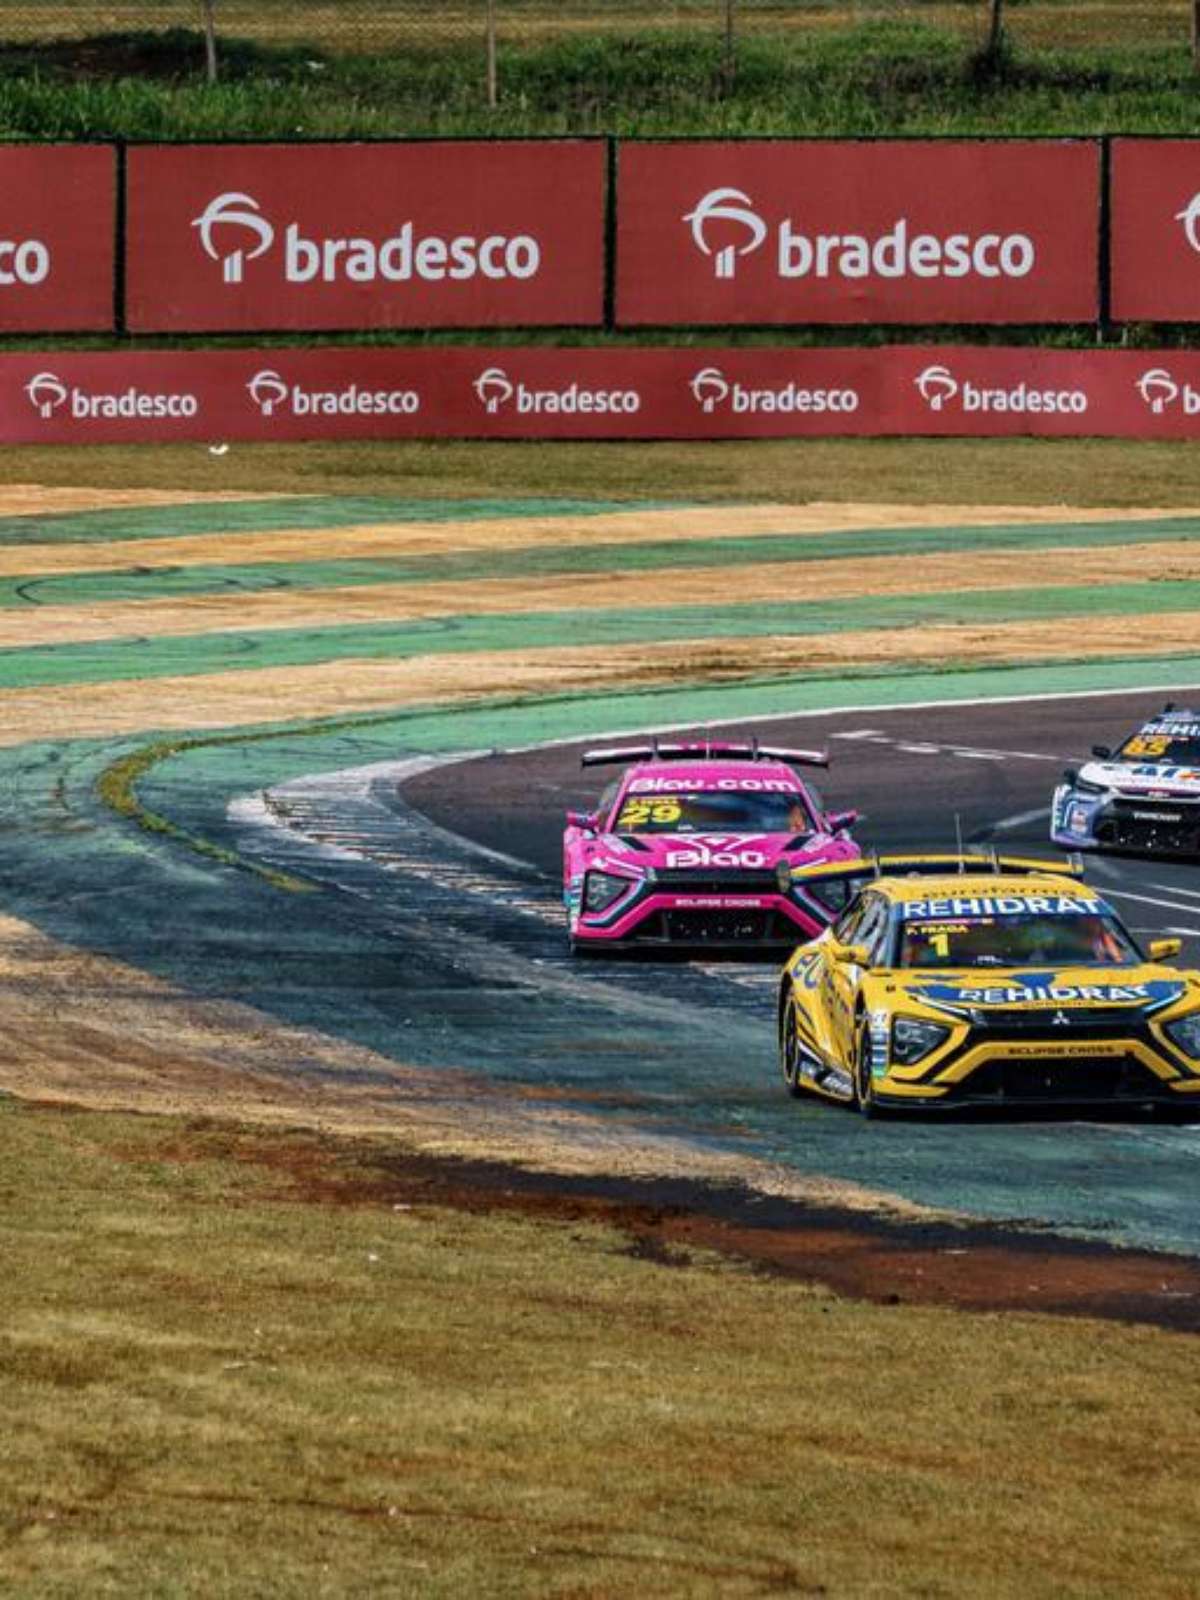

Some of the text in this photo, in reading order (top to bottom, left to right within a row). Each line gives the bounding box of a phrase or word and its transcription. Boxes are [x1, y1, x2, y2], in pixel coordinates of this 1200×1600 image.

[0, 240, 49, 285] co
[285, 221, 540, 282] bradesco
[778, 218, 1035, 278] bradesco
[72, 387, 198, 418] bradesco
[293, 385, 419, 415] bradesco
[517, 383, 640, 413] bradesco
[732, 383, 859, 413] bradesco
[962, 381, 1088, 414] bradesco
[617, 805, 682, 825] 29
[675, 898, 761, 907] ECLIPSE CROSS
[903, 896, 1100, 918] REHIDRAT
[928, 933, 949, 957] 1
[958, 985, 1149, 1004] REHIDRAT
[1069, 1045, 1114, 1056] CROSS
